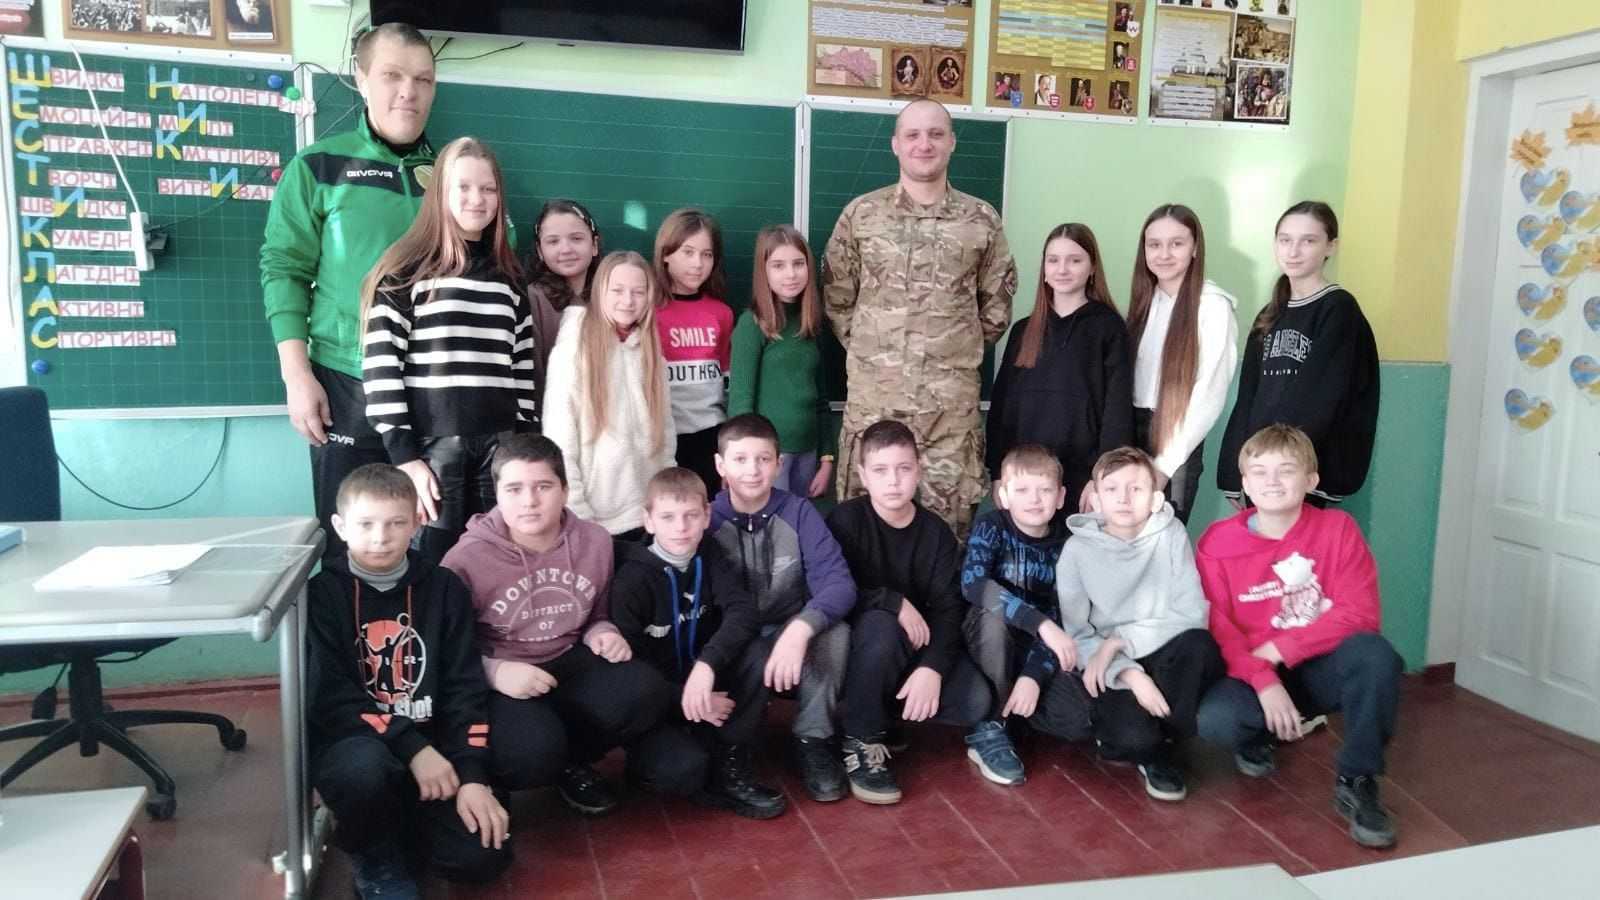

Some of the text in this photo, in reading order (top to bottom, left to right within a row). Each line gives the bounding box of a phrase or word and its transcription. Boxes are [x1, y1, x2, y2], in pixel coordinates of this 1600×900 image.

[28, 285, 143, 317] АКТИВНІ
[31, 316, 175, 349] СПОРТИВНІ
[669, 327, 717, 348] SMILE
